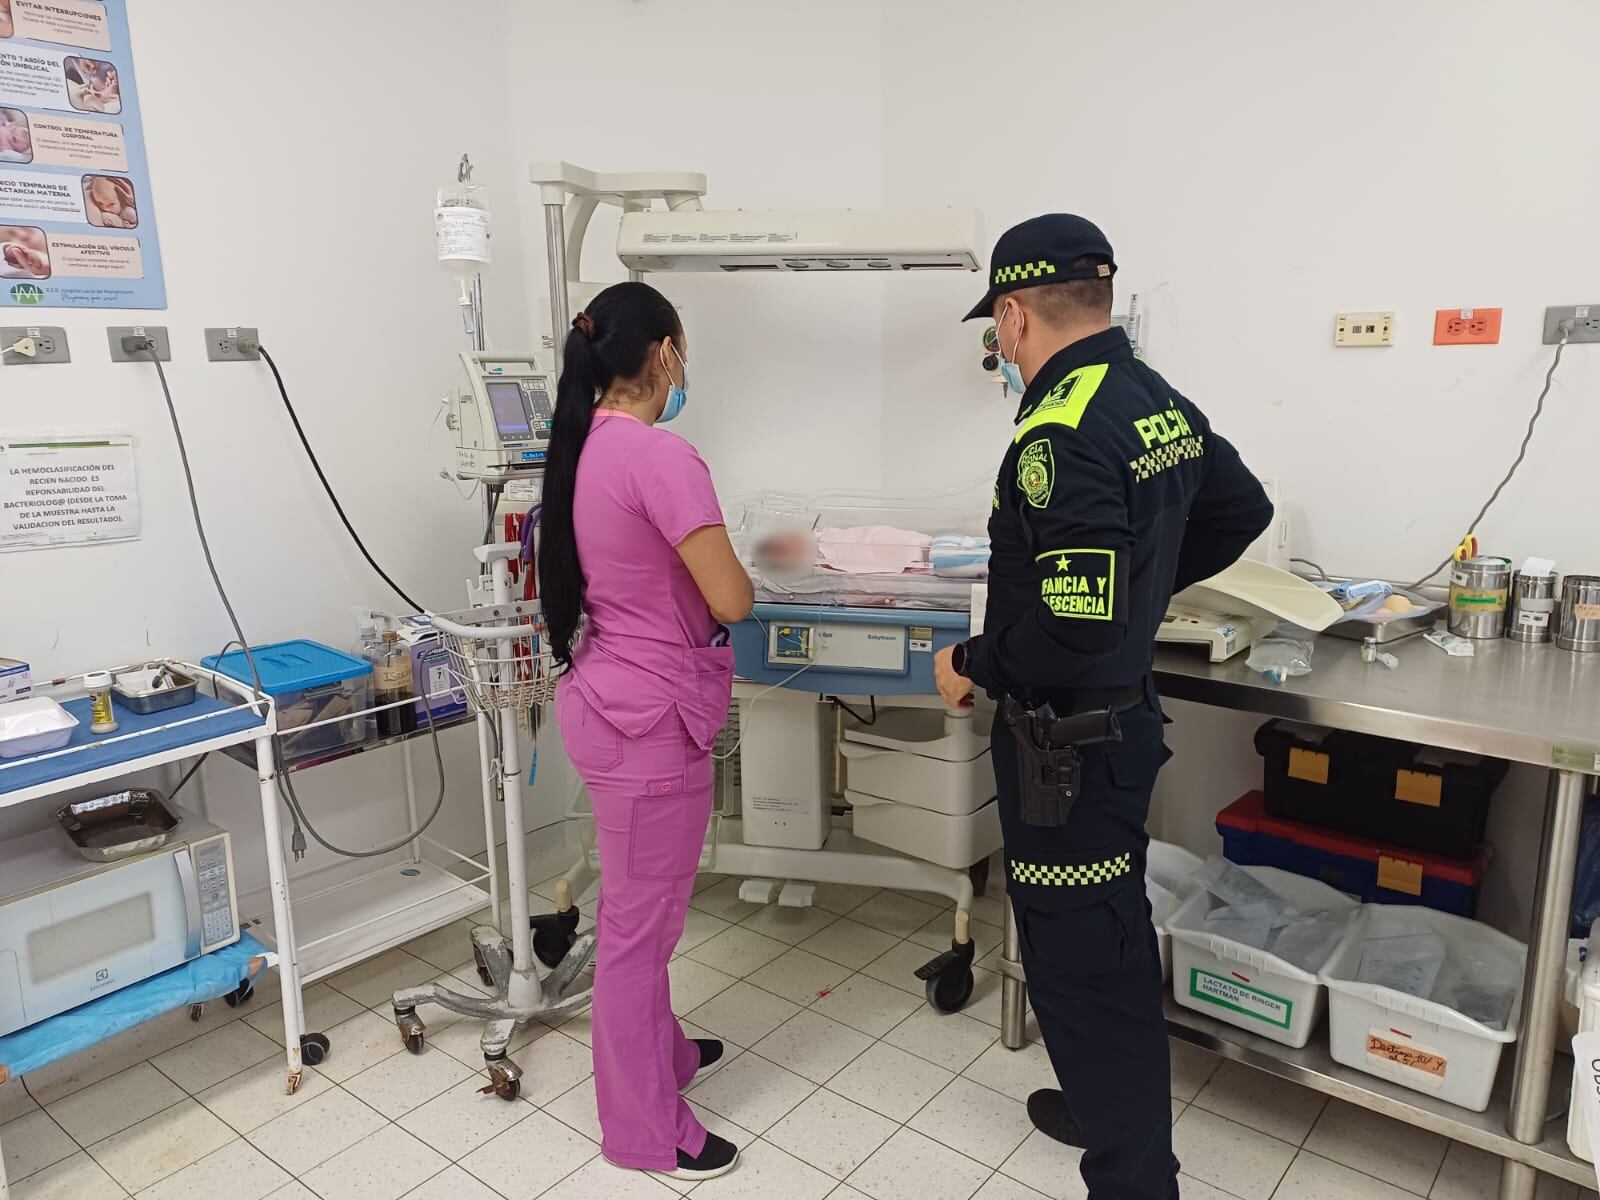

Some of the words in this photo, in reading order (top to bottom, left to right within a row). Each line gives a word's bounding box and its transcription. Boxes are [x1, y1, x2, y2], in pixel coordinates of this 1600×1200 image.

[16, 0, 43, 11] EVITAR
[44, 4, 102, 21] INTERRUPCIONES
[12, 62, 50, 72] UMBILICAL
[34, 123, 62, 132] CONTROL
[74, 127, 118, 138] TEMPERATURA
[62, 132, 94, 141] CORPORAL
[19, 181, 57, 190] TEMPRANO
[36, 189, 71, 198] MATERNA
[51, 241, 96, 250] ESTIMULACIÓN
[1132, 398, 1193, 449] POLCÍA
[21, 464, 101, 474] HEMOCLASIFICACIÓN
[25, 486, 91, 496] REPONSABILIDAD
[4, 498, 65, 509] BACTERIOLOG@
[67, 497, 93, 506] (DESDE
[43, 508, 80, 517] MUESTRA
[13, 519, 60, 530] VALIDACION
[1096, 576, 1107, 595] Y
[1043, 595, 1106, 614] ESCENCIA
[1202, 983, 1240, 1002] HARTMAN
[1203, 976, 1239, 994] LACTATO
[1239, 990, 1251, 999] DE
[1251, 995, 1281, 1011] RINGER
